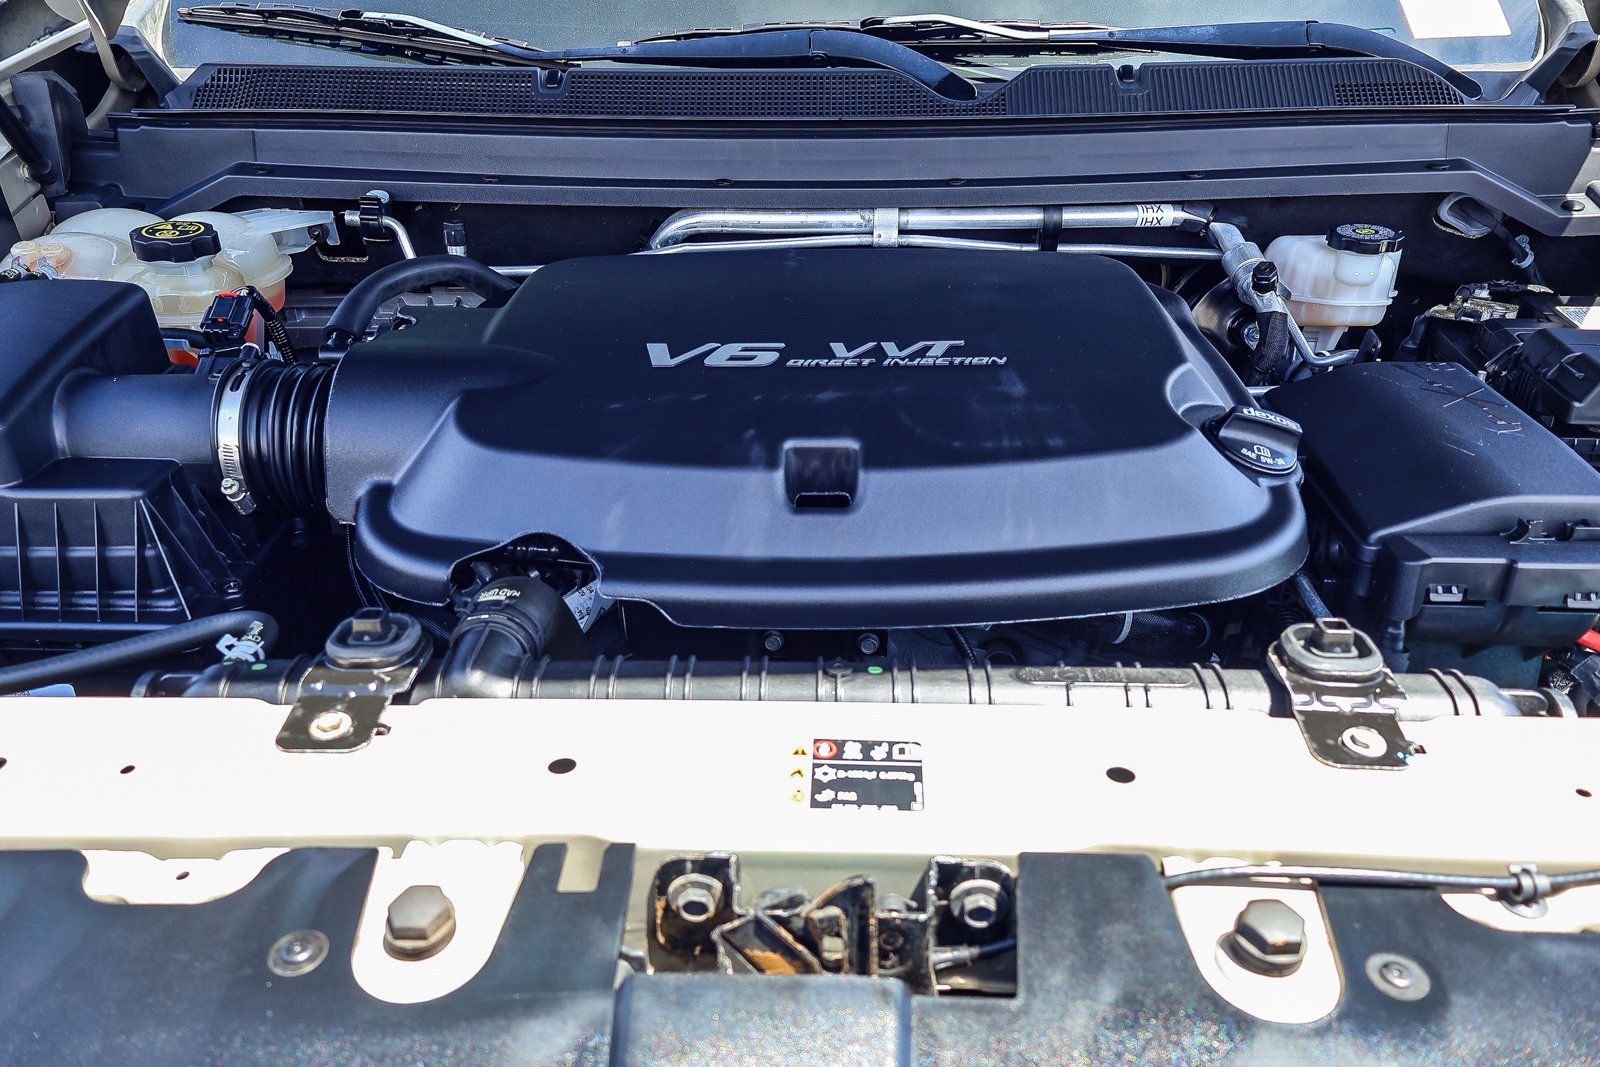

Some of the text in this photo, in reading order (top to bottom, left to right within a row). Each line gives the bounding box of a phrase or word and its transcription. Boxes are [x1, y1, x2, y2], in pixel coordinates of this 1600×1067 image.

[1140, 204, 1164, 213] IHX
[1139, 216, 1164, 227] IHX
[646, 340, 965, 367] V6 VVT
[786, 356, 1008, 367] DIRECT INJECTION
[1240, 447, 1257, 460] SAE
